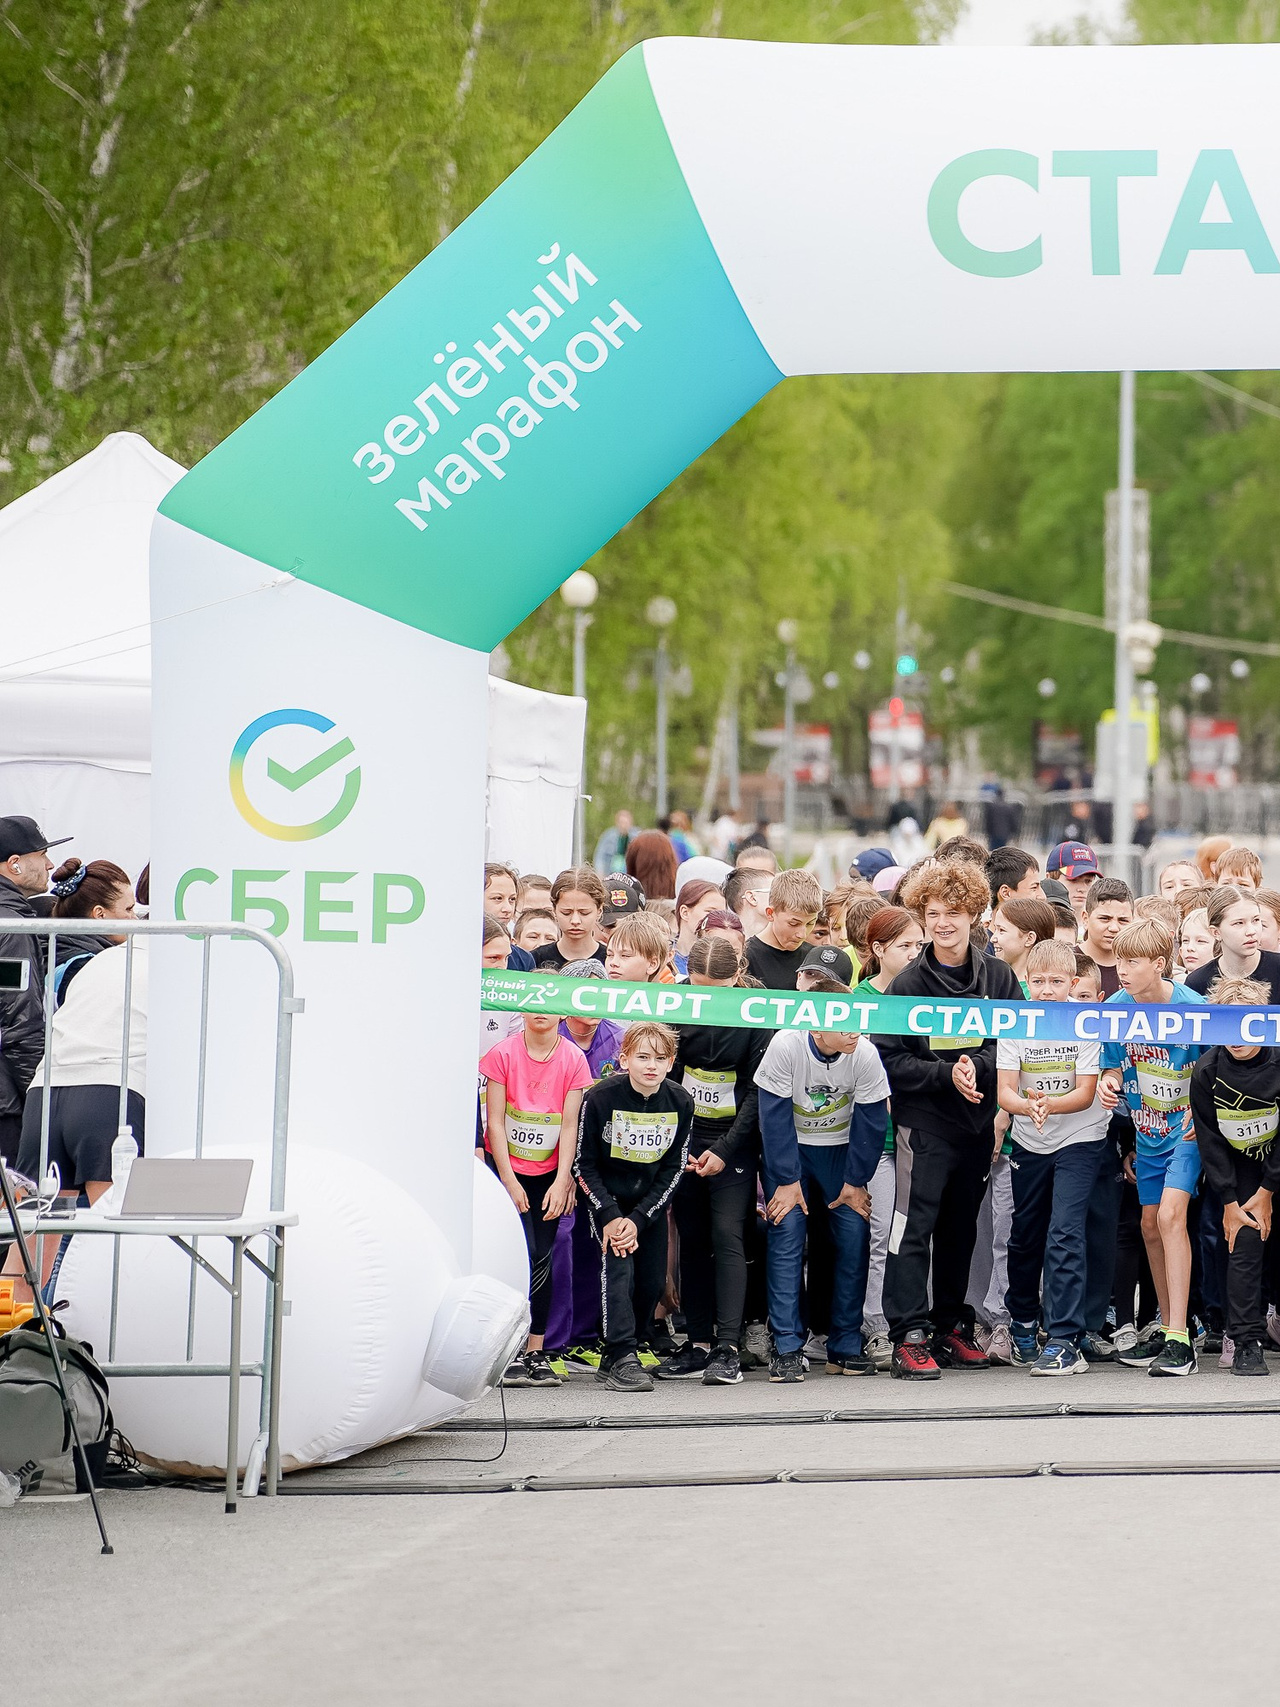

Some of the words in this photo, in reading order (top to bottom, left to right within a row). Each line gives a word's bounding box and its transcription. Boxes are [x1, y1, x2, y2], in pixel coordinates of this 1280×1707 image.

[352, 241, 599, 485] зелёный
[393, 298, 643, 532] марафон
[174, 867, 426, 945] СБЕР
[480, 988, 518, 1003] афон
[570, 985, 712, 1019] СТАРТ
[740, 996, 878, 1030] СТАРТ
[907, 1004, 1046, 1038] СТАРТ
[1073, 1009, 1211, 1042] СТАРТ
[1024, 1047, 1051, 1057] CYBER
[1054, 1045, 1079, 1054] MIND
[1036, 1079, 1070, 1091] 3173
[1151, 1084, 1182, 1098] 3119
[691, 1086, 720, 1104] 3105
[802, 1117, 837, 1128] 3149
[1236, 1122, 1269, 1137] 3111
[510, 1128, 544, 1145] 3095
[628, 1134, 662, 1146] 3150
